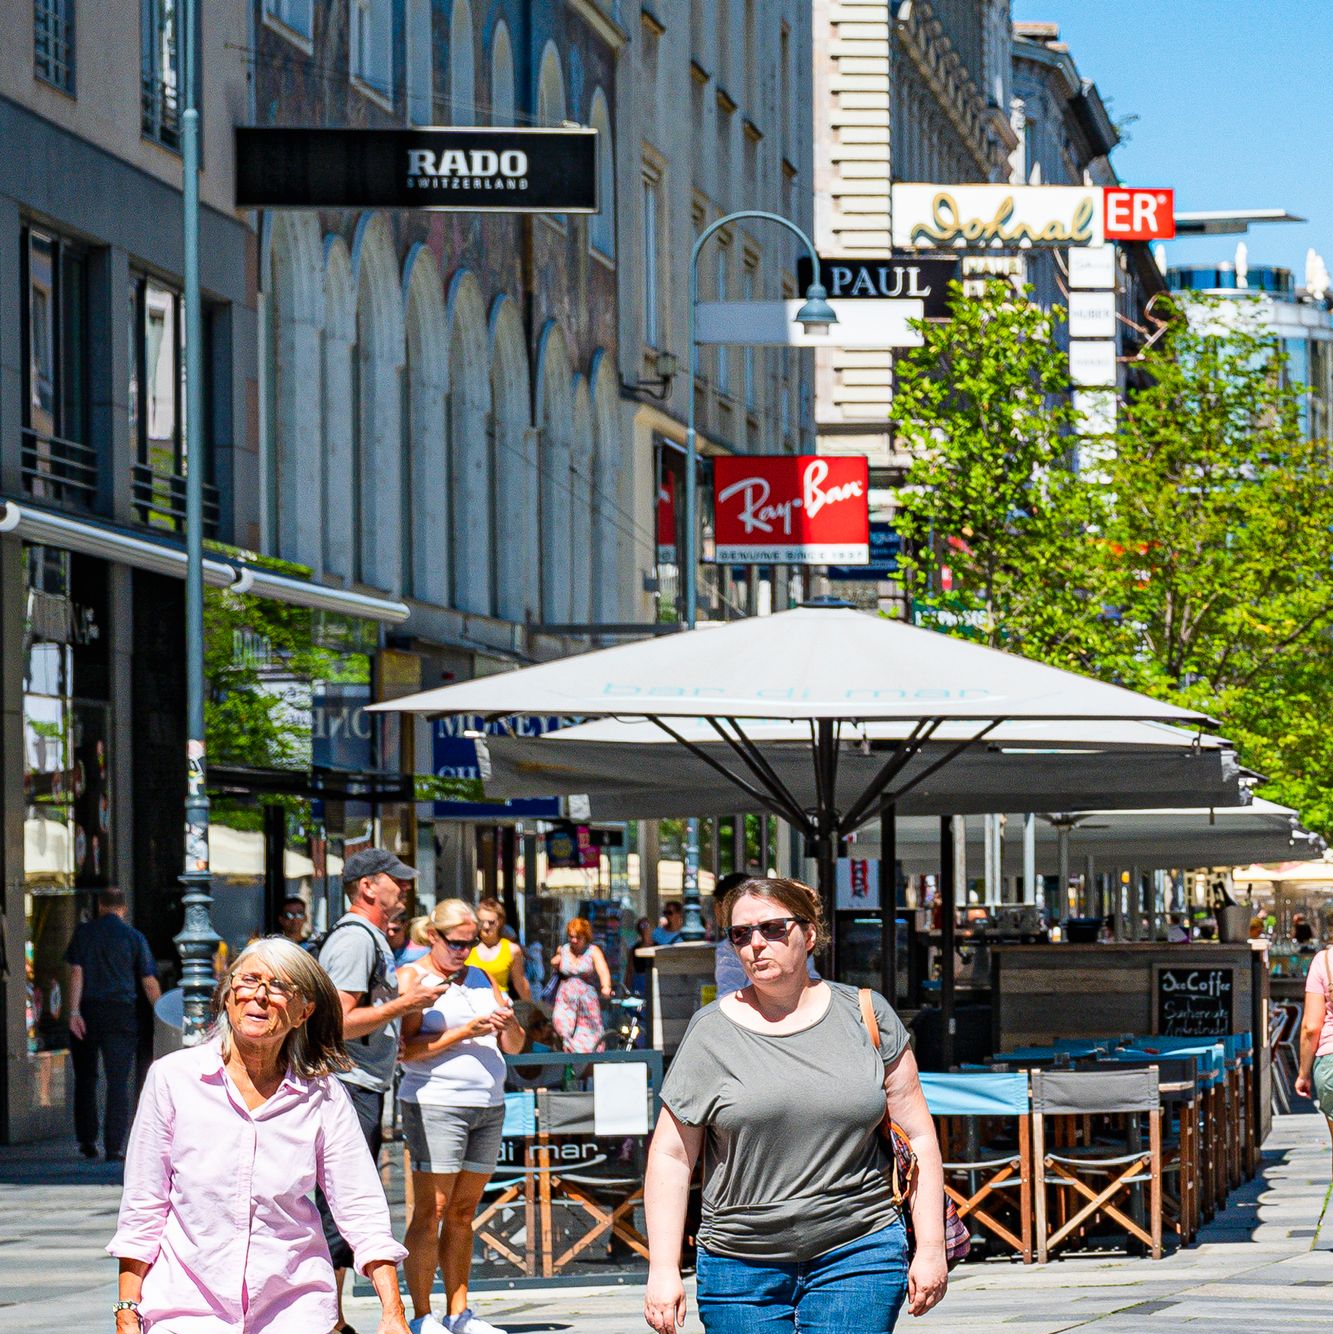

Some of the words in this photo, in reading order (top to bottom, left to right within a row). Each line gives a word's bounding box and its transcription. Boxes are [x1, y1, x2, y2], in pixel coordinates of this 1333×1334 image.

[407, 149, 528, 177] RADO
[406, 178, 529, 190] SWITZERLAND
[831, 266, 931, 298] PAUL
[602, 682, 726, 696] bar
[757, 687, 810, 698] di
[845, 687, 990, 699] mar
[529, 1143, 599, 1159] mar
